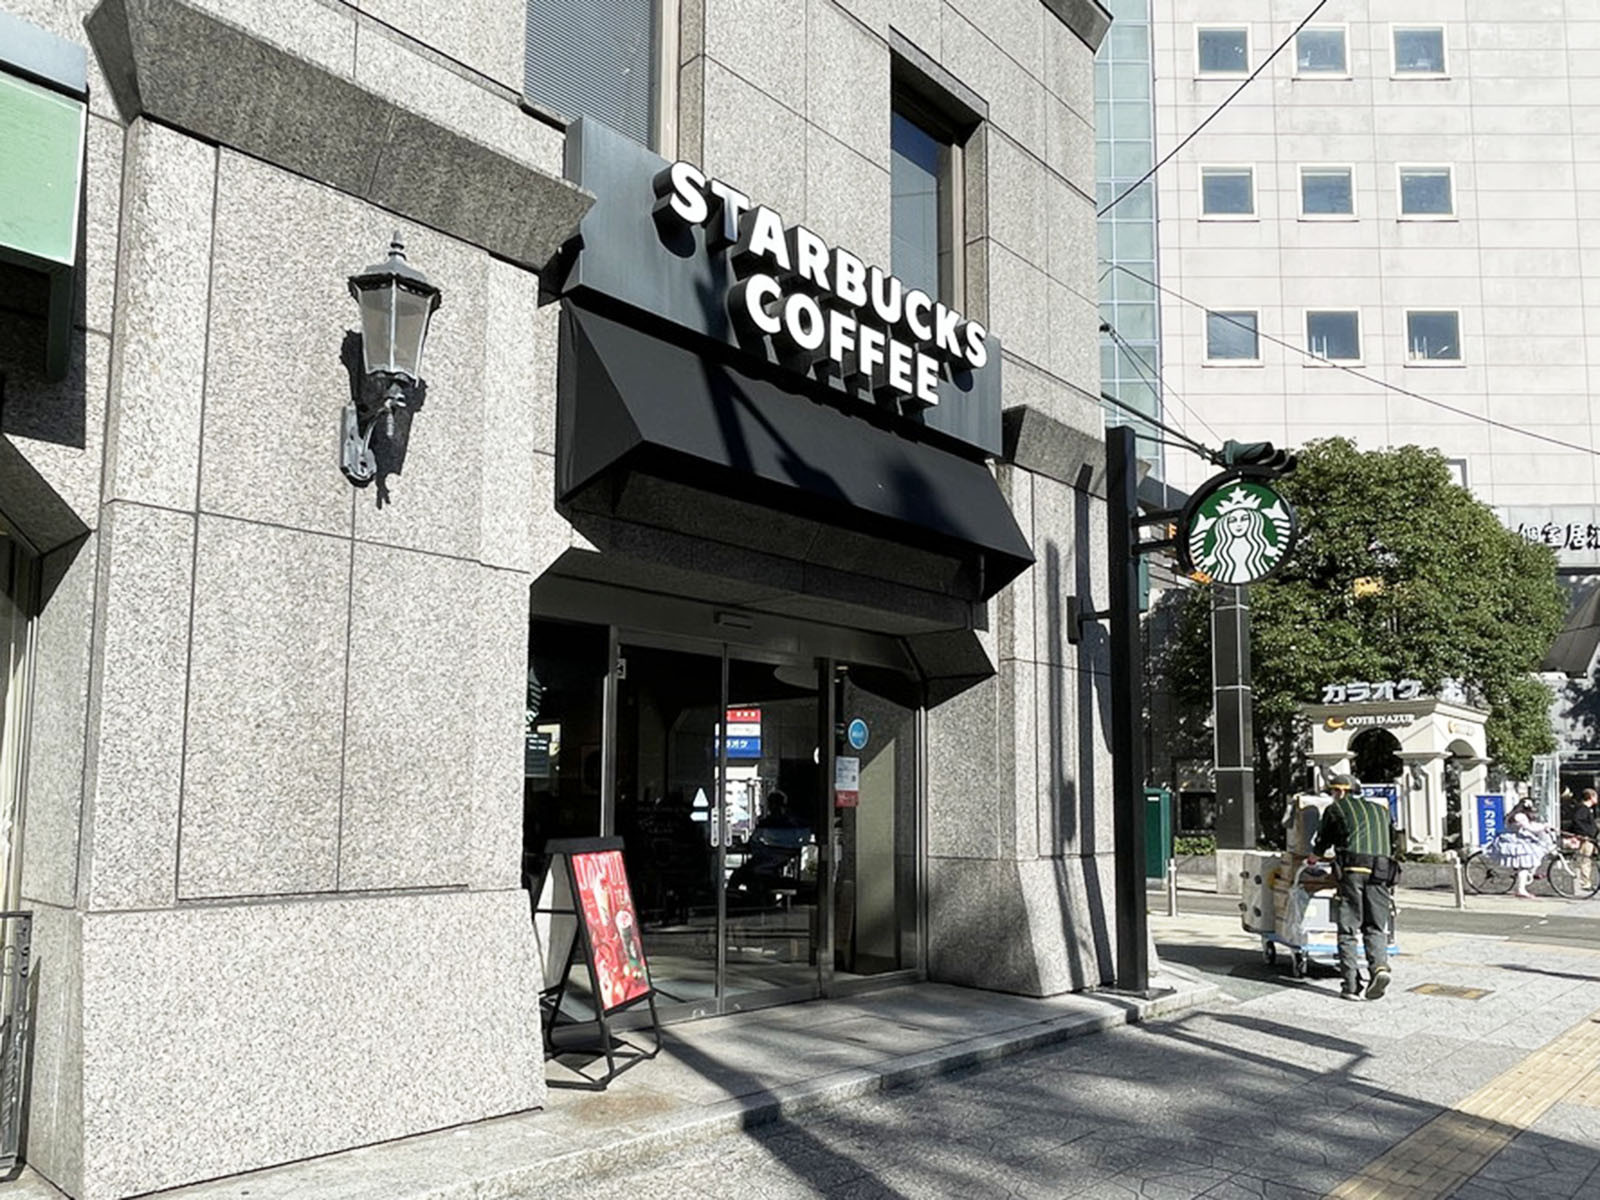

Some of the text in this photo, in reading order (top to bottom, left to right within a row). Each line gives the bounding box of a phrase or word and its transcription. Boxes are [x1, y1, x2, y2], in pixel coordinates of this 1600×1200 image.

[669, 160, 987, 369] STARBUCKS
[744, 273, 939, 406] COFFEE
[1321, 678, 1422, 703] カラオケ
